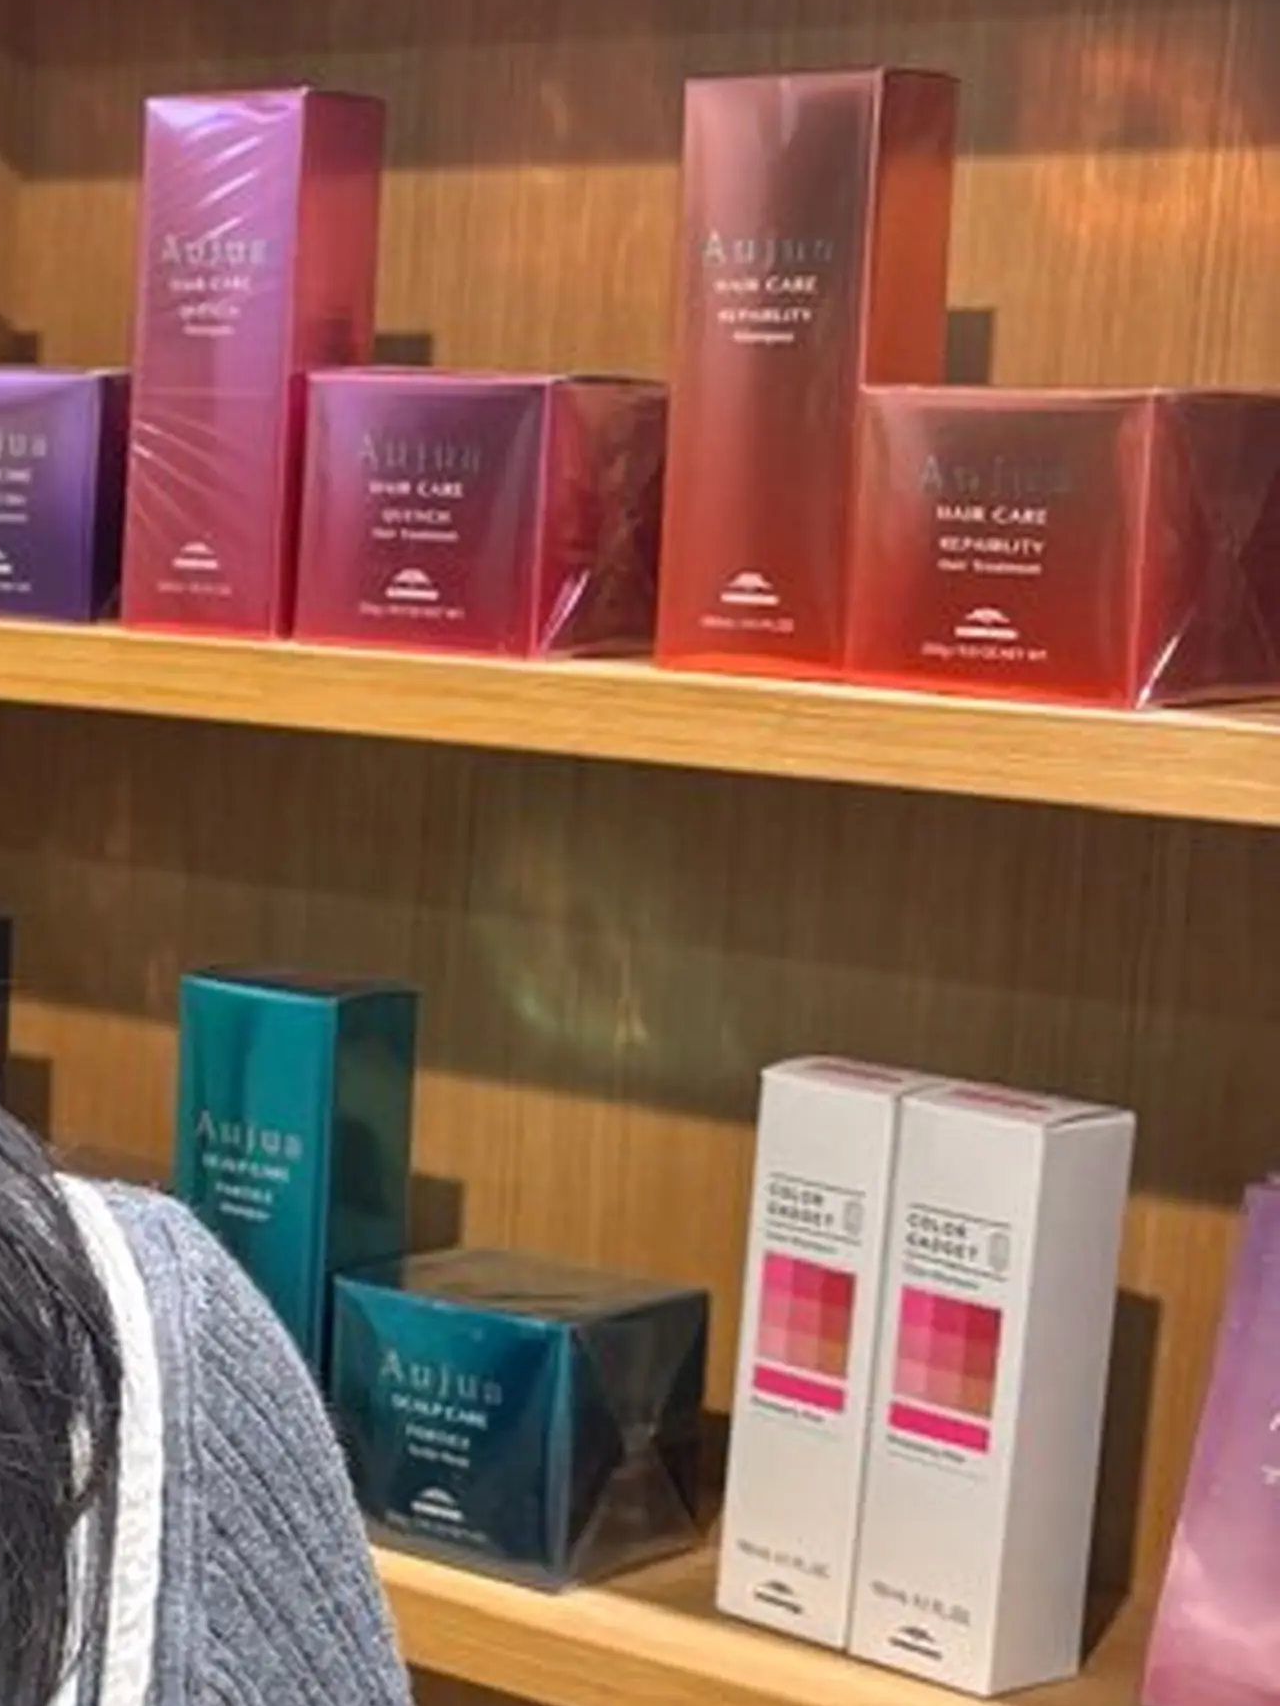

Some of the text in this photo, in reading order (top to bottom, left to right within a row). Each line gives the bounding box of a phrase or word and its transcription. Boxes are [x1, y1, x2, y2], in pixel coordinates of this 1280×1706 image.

[416, 479, 464, 498] CARE
[936, 504, 1047, 526] HAIR CARE
[196, 1108, 303, 1160] Aujua
[904, 1211, 967, 1239] COLOR
[380, 1348, 503, 1406] Aujua
